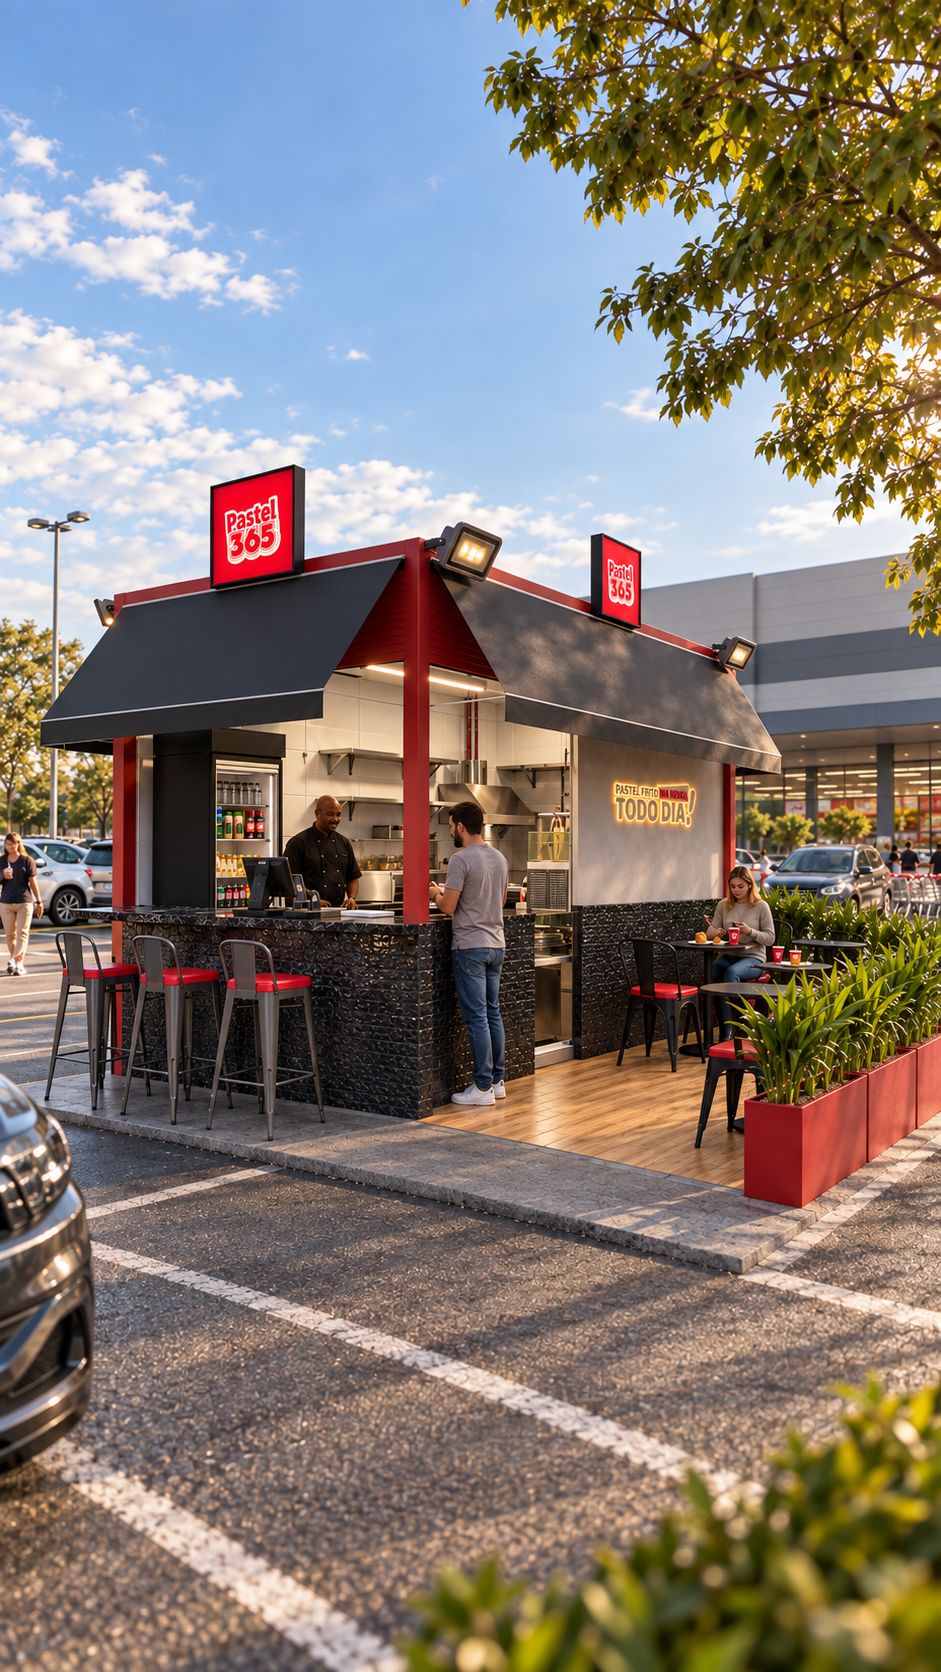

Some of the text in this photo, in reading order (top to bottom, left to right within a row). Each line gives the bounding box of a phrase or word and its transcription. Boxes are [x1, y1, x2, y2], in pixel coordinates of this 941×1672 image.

[225, 496, 278, 533] Pastel
[228, 523, 280, 563] 365
[608, 560, 633, 582] Pastel
[609, 578, 634, 605] 365
[615, 784, 640, 797] PASTEL
[615, 797, 658, 822] TODO
